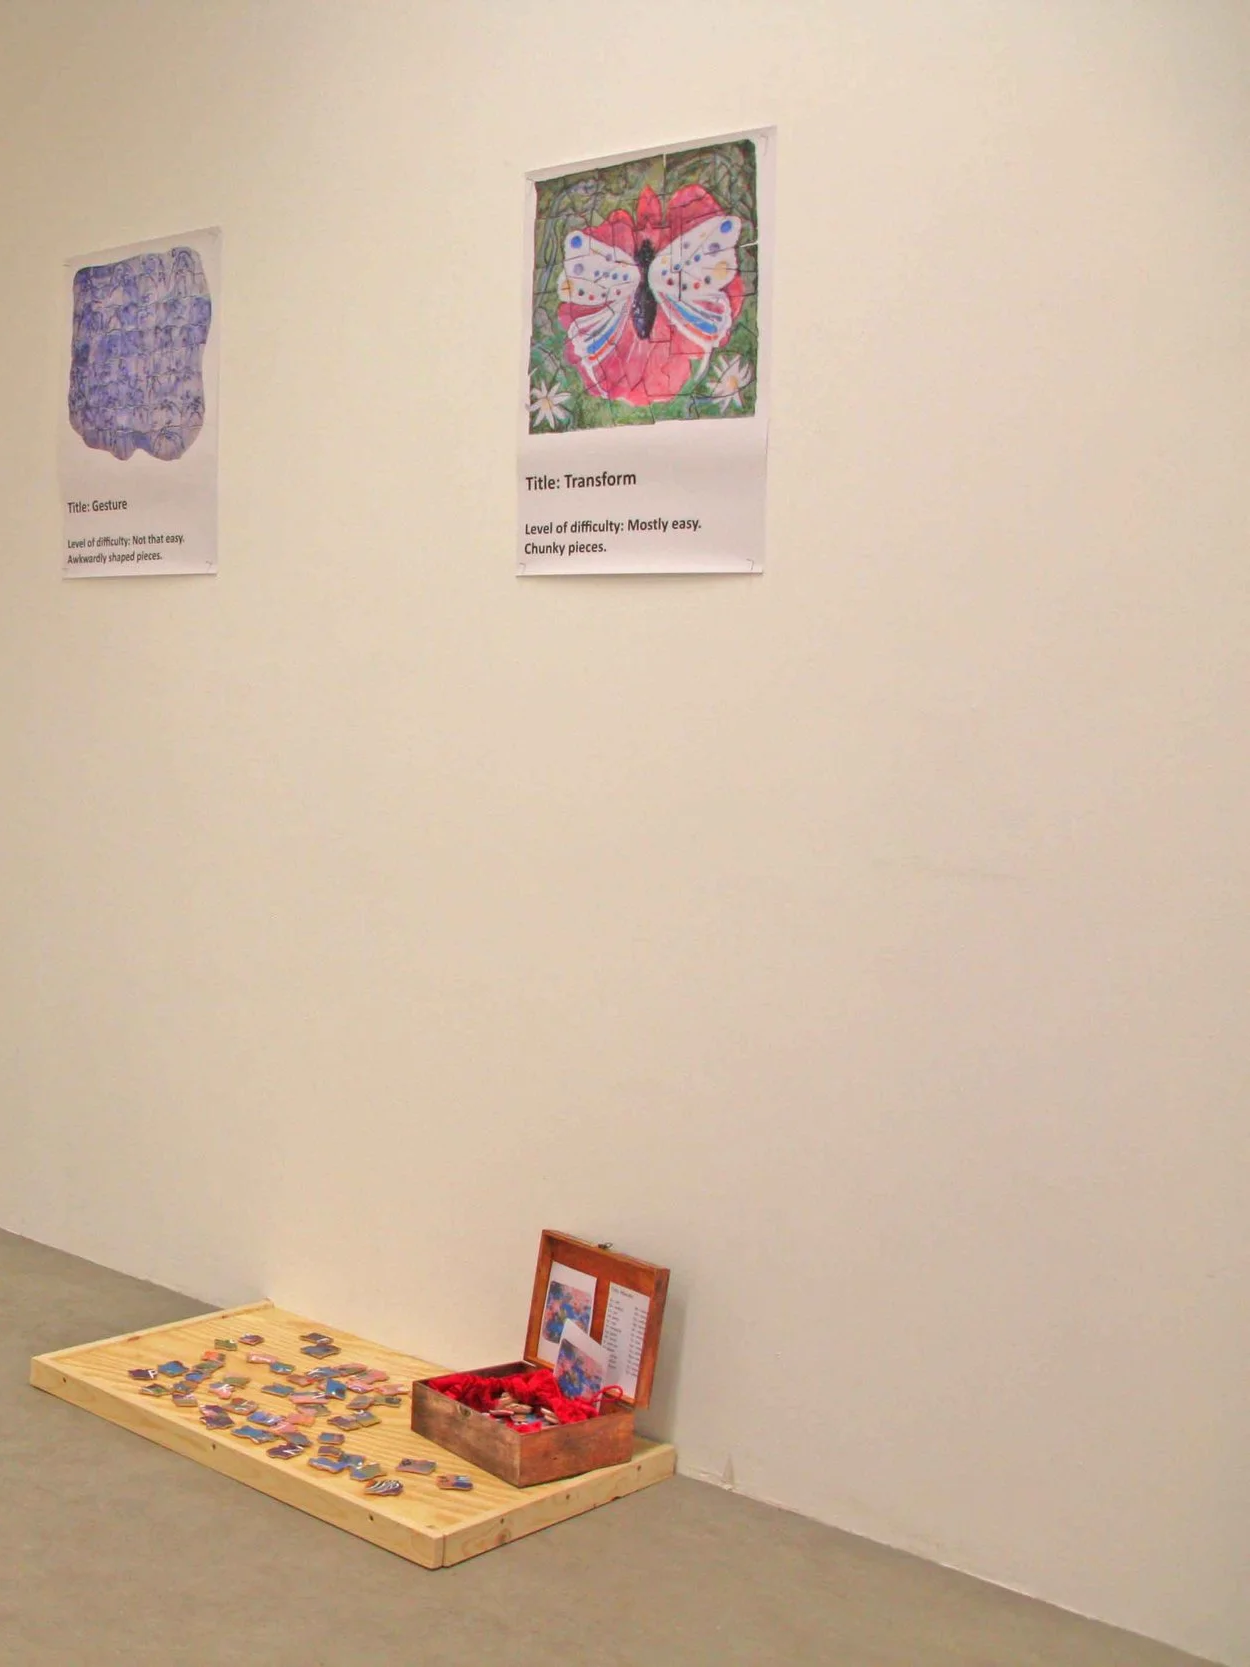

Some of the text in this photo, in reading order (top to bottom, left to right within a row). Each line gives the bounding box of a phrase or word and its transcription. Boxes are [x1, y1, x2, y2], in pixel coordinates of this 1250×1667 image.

[526, 471, 636, 491] Title: Transform
[68, 500, 127, 513] Title: Gesture
[525, 517, 702, 535] Level of difficulty: Mostly easy.
[68, 534, 185, 548] Level of difficulty: Not that easy.
[525, 540, 606, 556] Chunky pieces.
[68, 551, 162, 564] Awkwardly shaped pieces.
